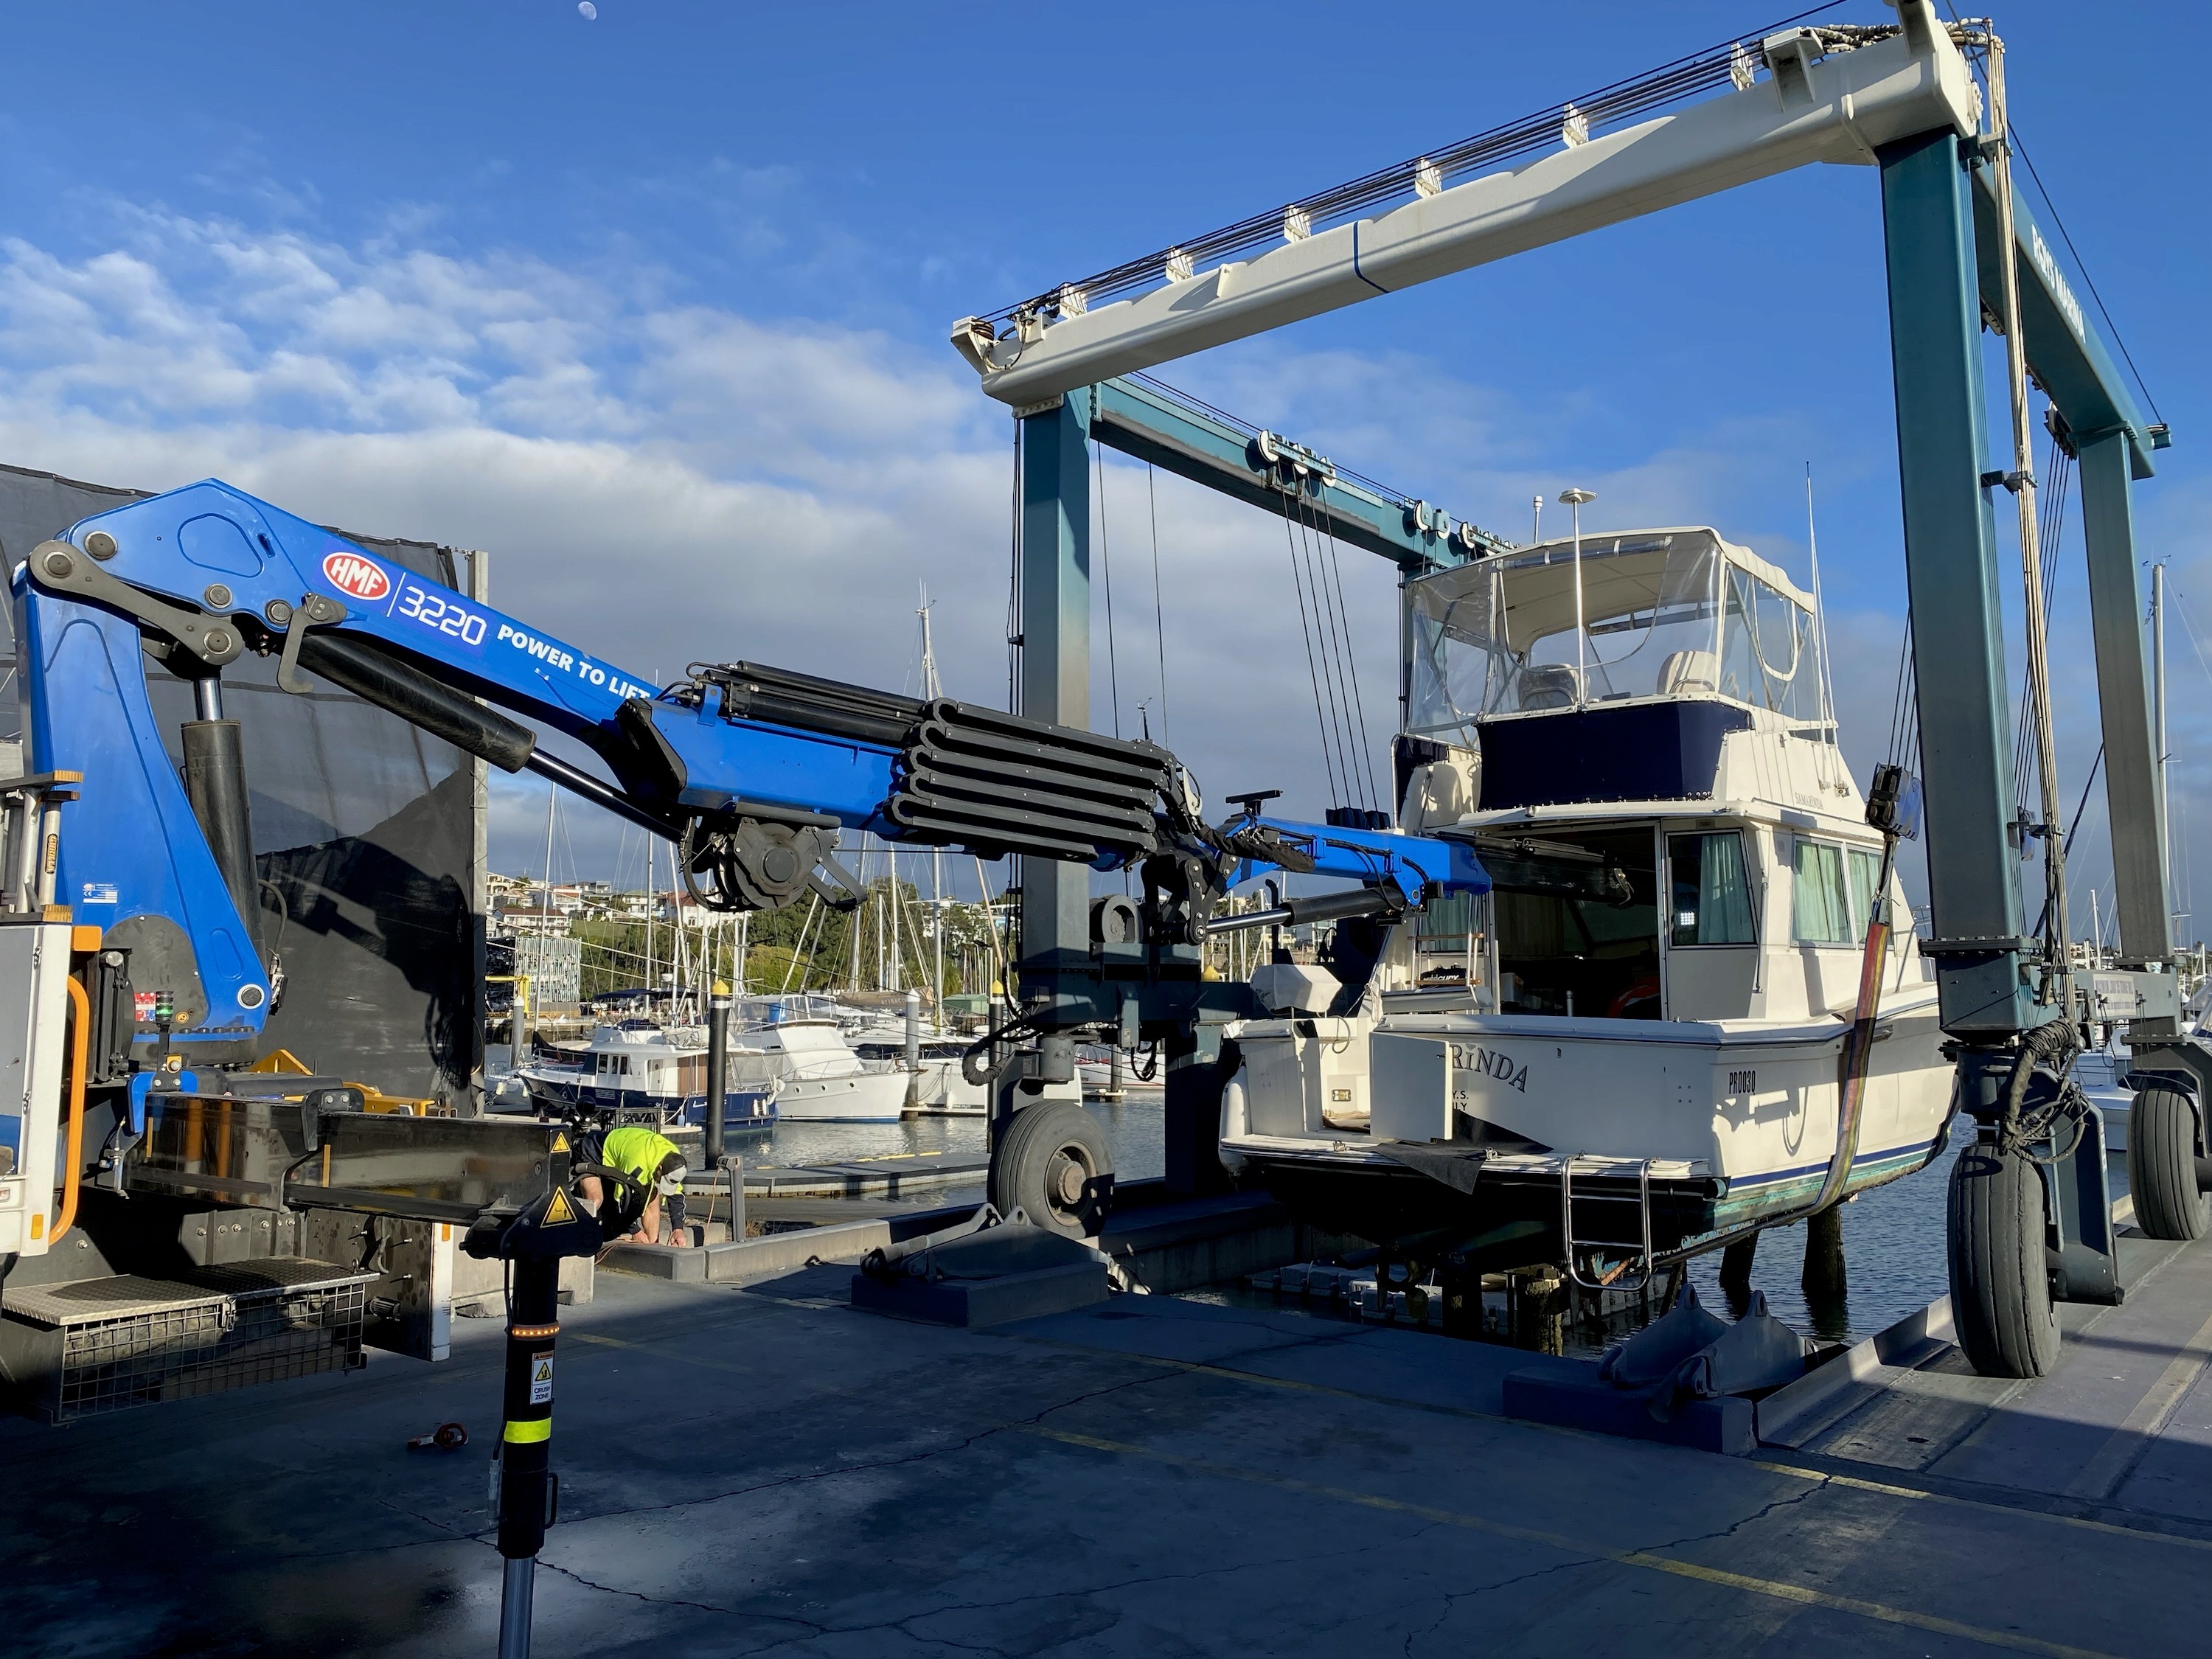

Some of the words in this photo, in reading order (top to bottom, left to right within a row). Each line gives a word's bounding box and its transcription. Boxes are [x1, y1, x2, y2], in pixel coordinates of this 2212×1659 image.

[330, 554, 383, 594] HMF
[398, 585, 487, 647] 3220
[497, 623, 574, 672] POWER
[579, 661, 605, 686] TO
